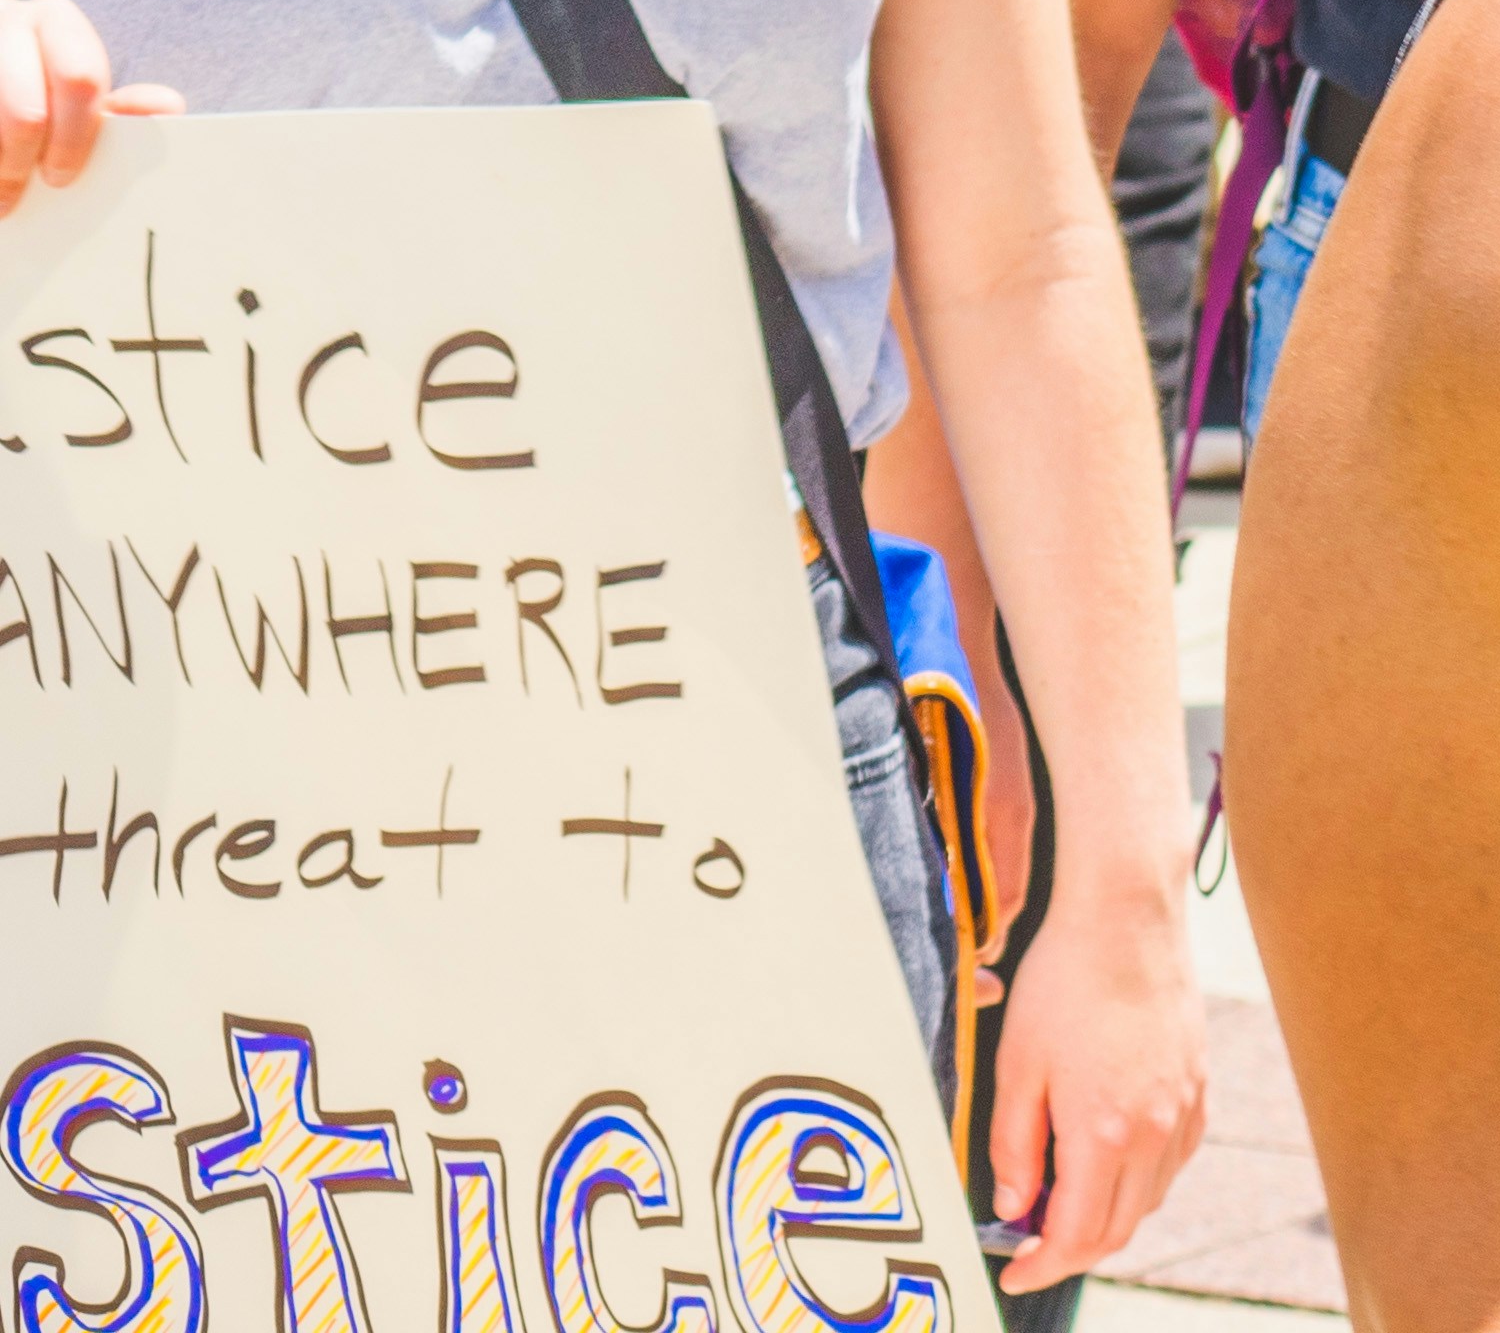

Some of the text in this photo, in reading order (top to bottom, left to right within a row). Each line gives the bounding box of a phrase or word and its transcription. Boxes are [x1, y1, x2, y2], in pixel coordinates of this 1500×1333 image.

[0, 227, 538, 469] stice
[0, 765, 747, 904] threat to
